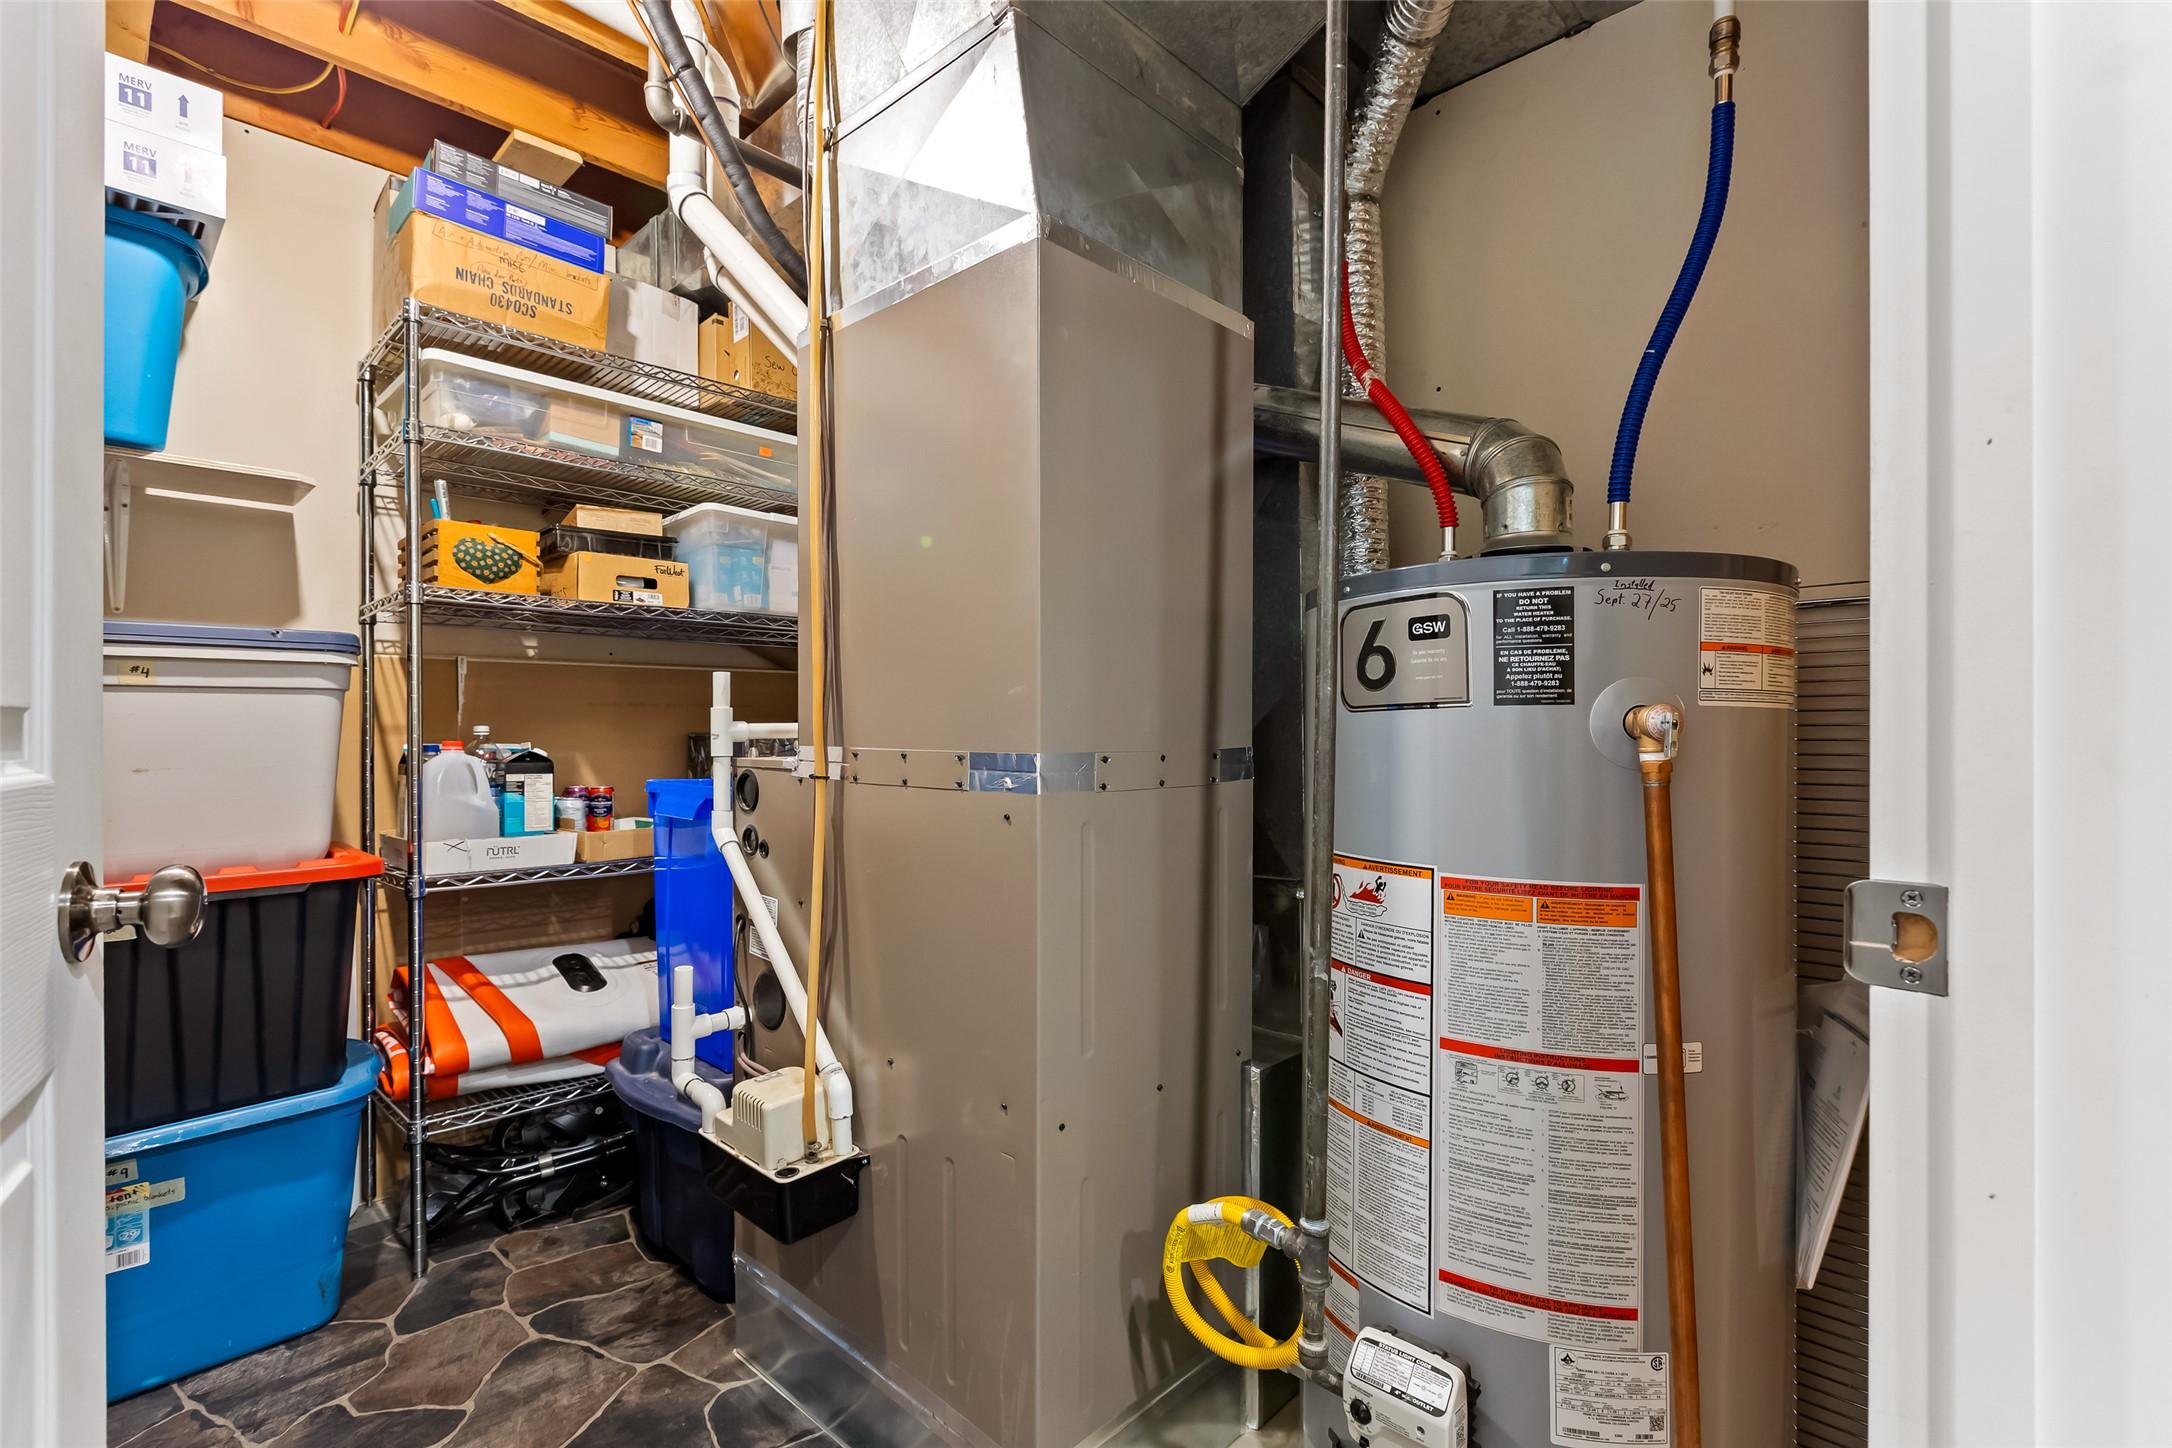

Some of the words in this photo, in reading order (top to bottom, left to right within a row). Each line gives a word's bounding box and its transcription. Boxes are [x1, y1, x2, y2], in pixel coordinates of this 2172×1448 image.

[118, 72, 152, 91] MERV
[124, 87, 146, 108] 11
[123, 141, 157, 158] MERV
[129, 156, 150, 175] 11
[456, 267, 495, 290] CHAIN
[502, 281, 573, 315] STANDARDS
[1614, 578, 1656, 590] Installed
[1594, 588, 1625, 606] Sept.
[1631, 589, 1682, 621] 27/25
[1412, 620, 1446, 635] GSW
[1357, 617, 1396, 692] 6
[129, 665, 150, 678] #4
[1533, 672, 1552, 680] plutôt
[1368, 864, 1423, 878] AVERTISSEMENT
[1348, 967, 1371, 981] DANGER
[1378, 1342, 1399, 1355] STATUS
[1399, 1351, 1416, 1362] LIGHT
[1416, 1359, 1432, 1370] CODE
[1412, 1397, 1434, 1412] OUTLET
